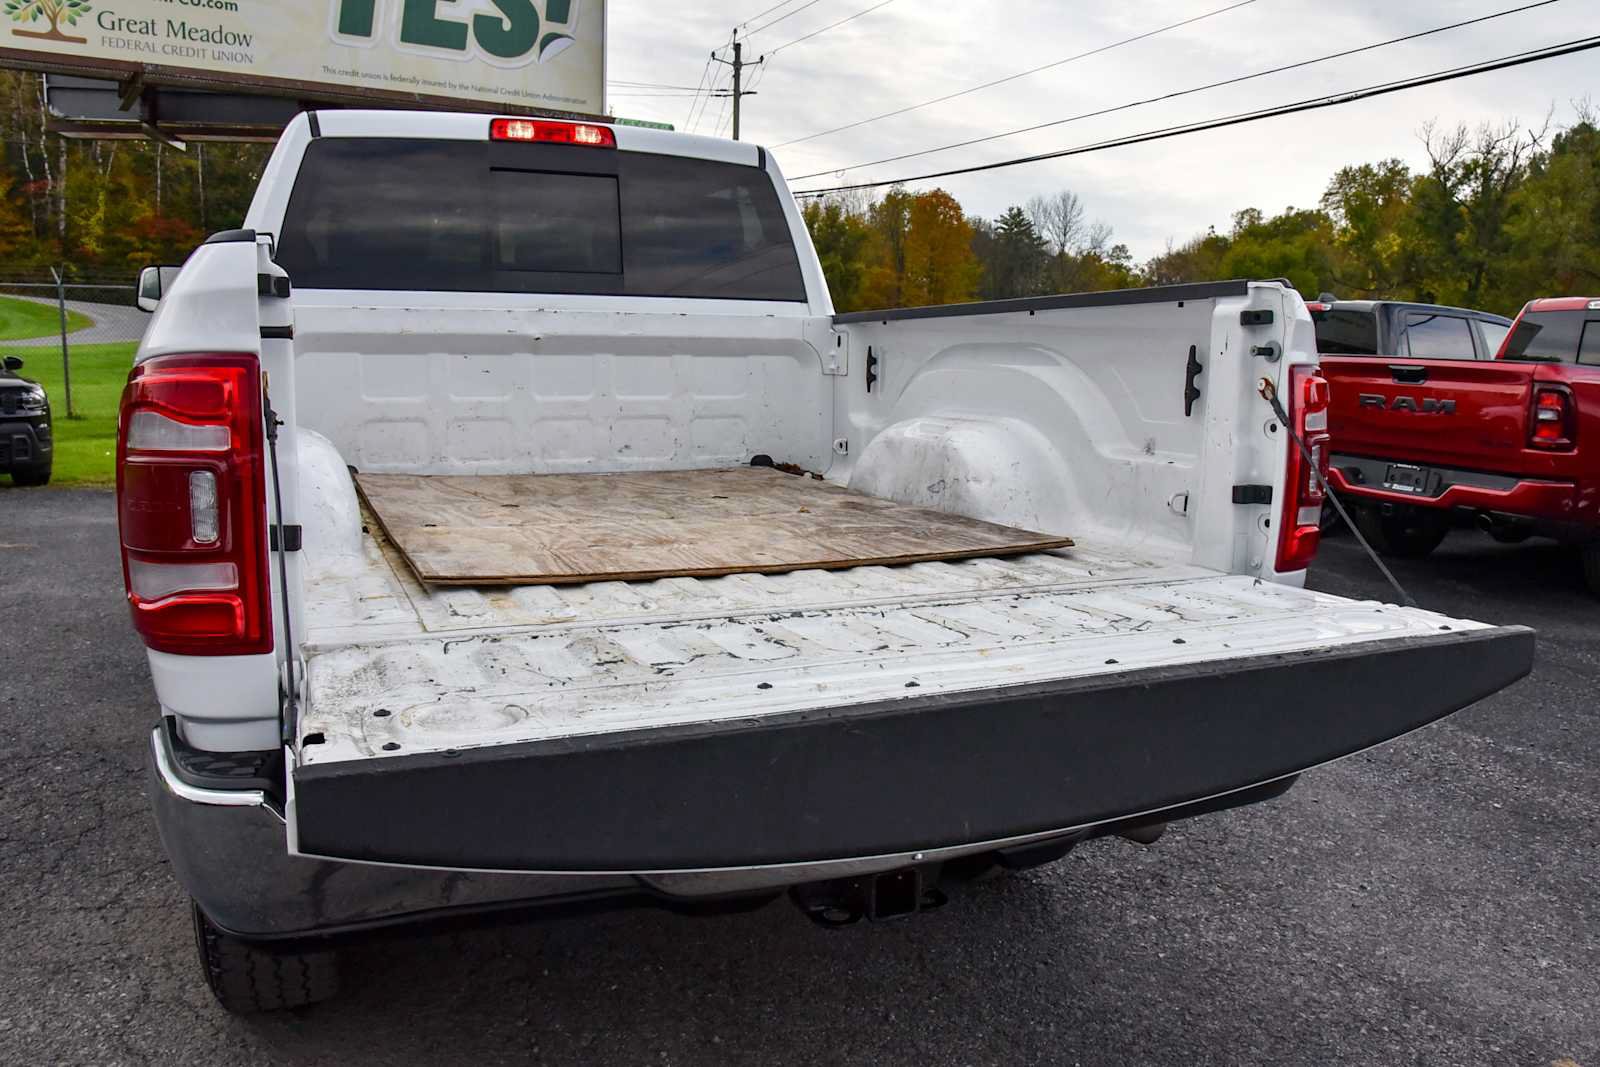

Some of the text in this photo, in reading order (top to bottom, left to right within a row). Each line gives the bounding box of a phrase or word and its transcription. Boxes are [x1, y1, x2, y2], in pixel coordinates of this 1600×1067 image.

[97, 10, 253, 48] Great Meadow
[338, 0, 576, 64] ES!
[101, 36, 254, 65] FEDERAL CREDIT UNION
[322, 65, 337, 75] This
[338, 68, 360, 78] credit
[360, 72, 382, 81] union
[390, 73, 420, 86] federally
[421, 79, 447, 89] insured
[448, 80, 457, 91] by
[459, 83, 470, 91] the
[471, 85, 499, 95] National
[500, 87, 521, 97] Credit
[521, 88, 542, 99] Union
[1360, 393, 1456, 414] RAM
